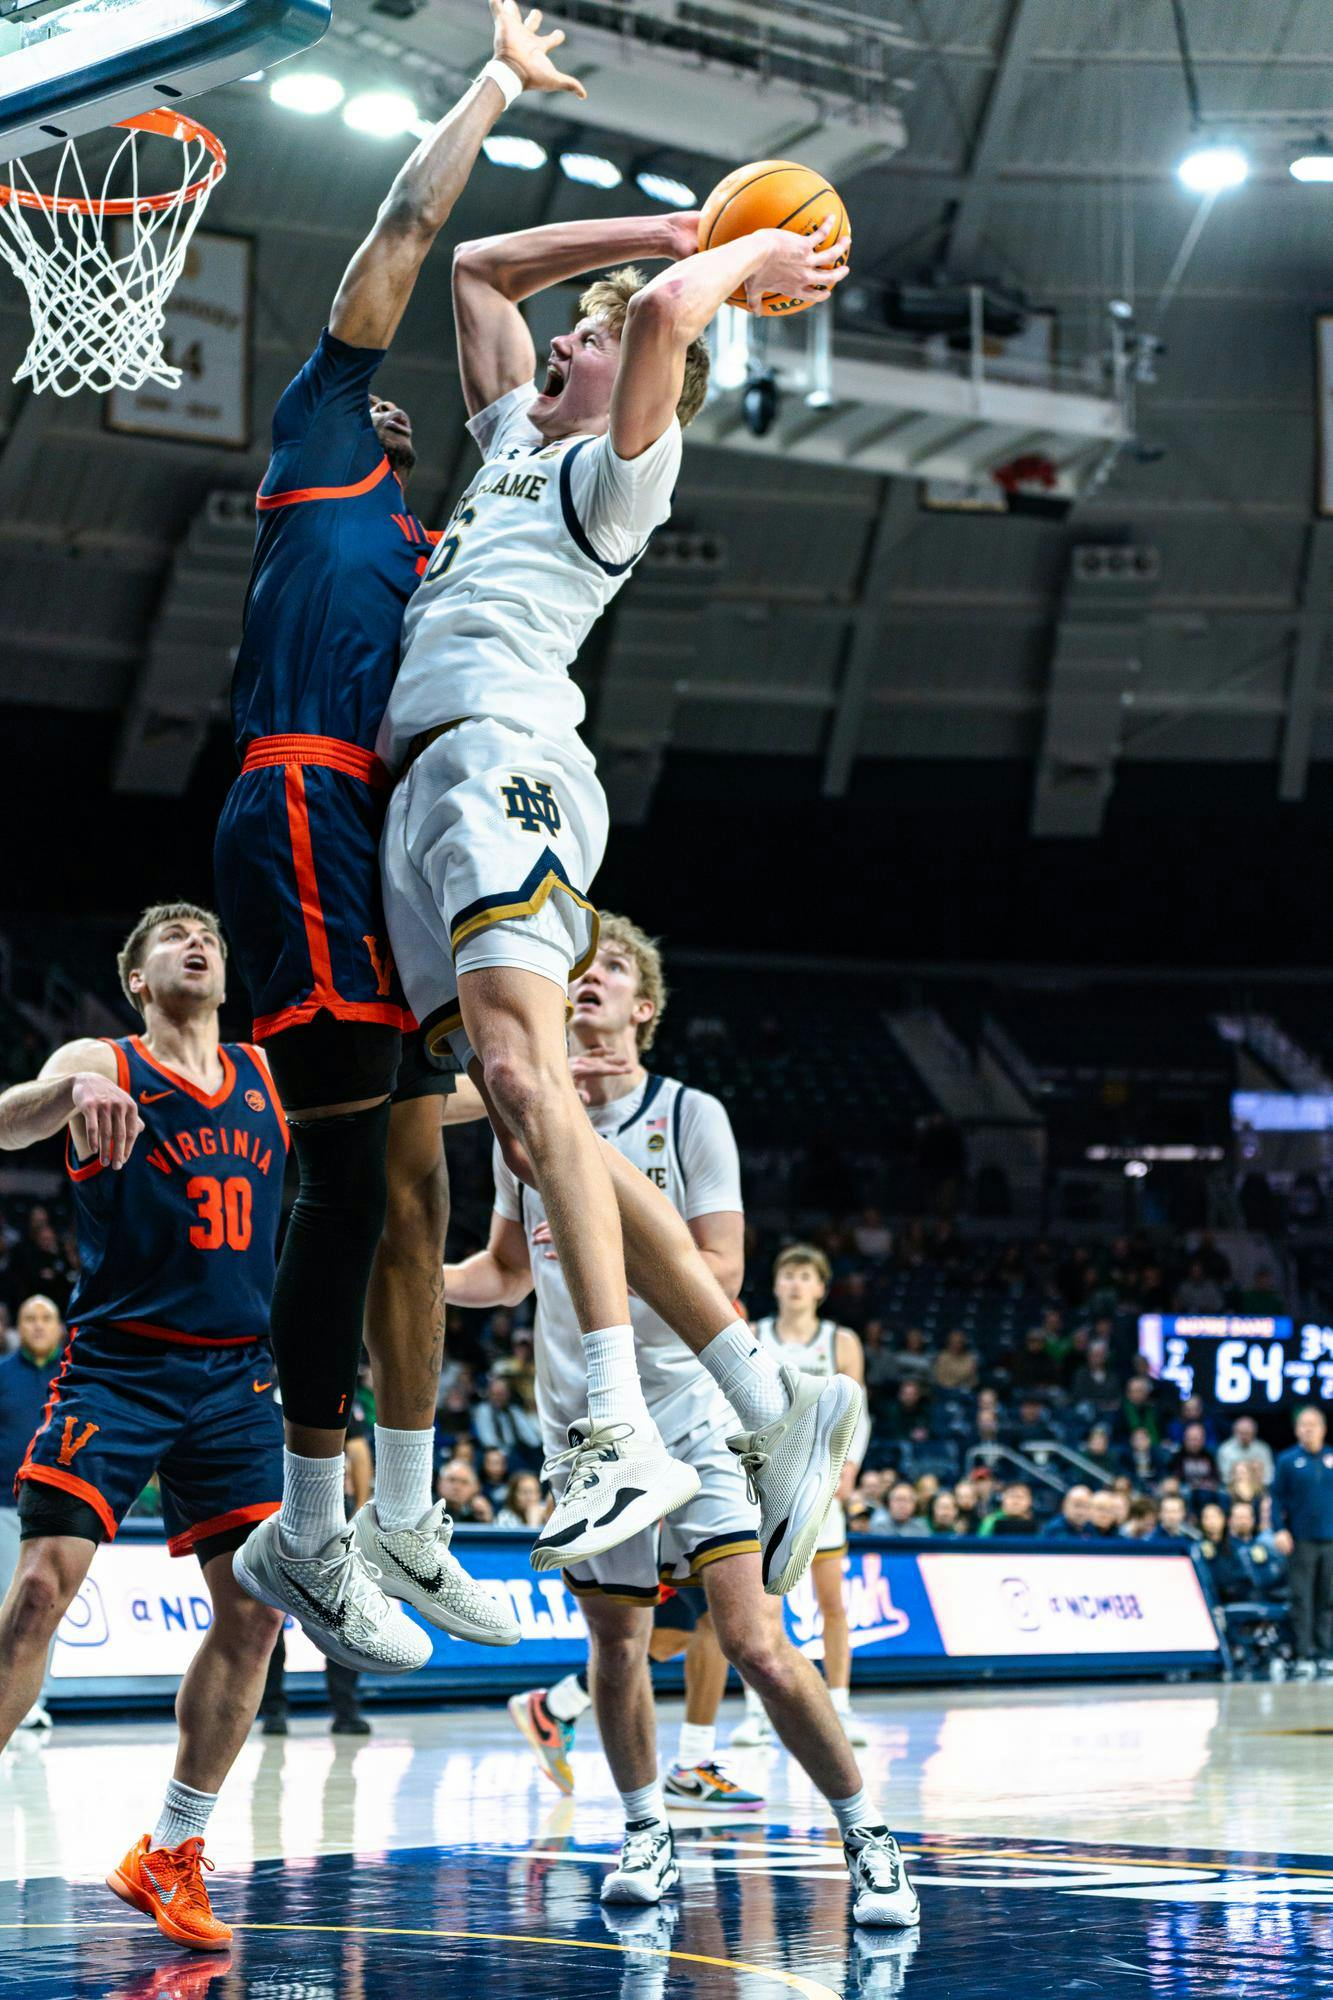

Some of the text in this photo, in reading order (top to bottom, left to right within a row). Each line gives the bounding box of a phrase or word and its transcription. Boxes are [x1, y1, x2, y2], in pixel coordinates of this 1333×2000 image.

[479, 473, 548, 502] AME
[145, 1127, 273, 1176] VIRGINIA
[186, 1175, 253, 1251] 30
[1215, 1340, 1284, 1403] 64
